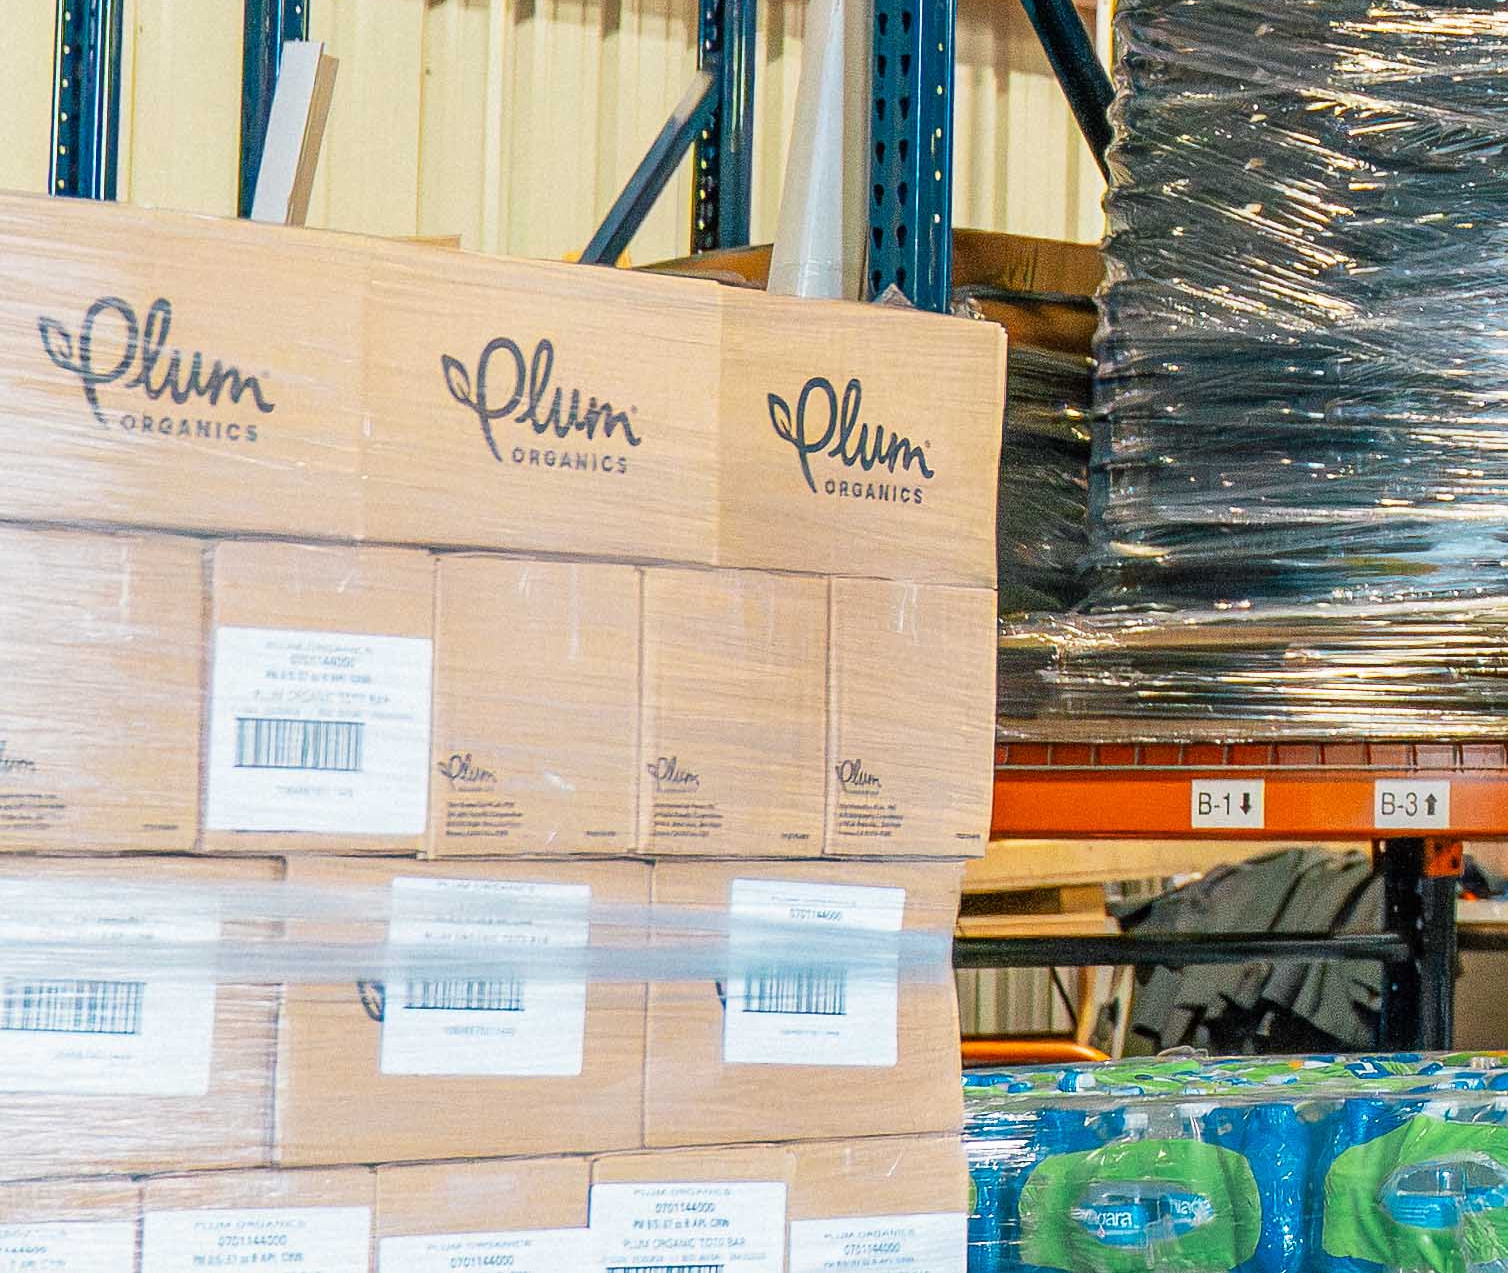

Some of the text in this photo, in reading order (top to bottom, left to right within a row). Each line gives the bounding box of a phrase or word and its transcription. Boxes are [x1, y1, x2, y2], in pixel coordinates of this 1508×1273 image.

[81, 296, 275, 423] Plum
[477, 337, 641, 462] Plum
[119, 414, 258, 442] ORGANICS
[797, 377, 935, 494] Plum
[512, 447, 628, 474] ORGANICS
[824, 479, 923, 505] ORGANICS
[654, 756, 700, 791] Plum
[839, 758, 883, 791] Plum
[1197, 793, 1233, 816] B-1
[1380, 792, 1418, 816] B-3
